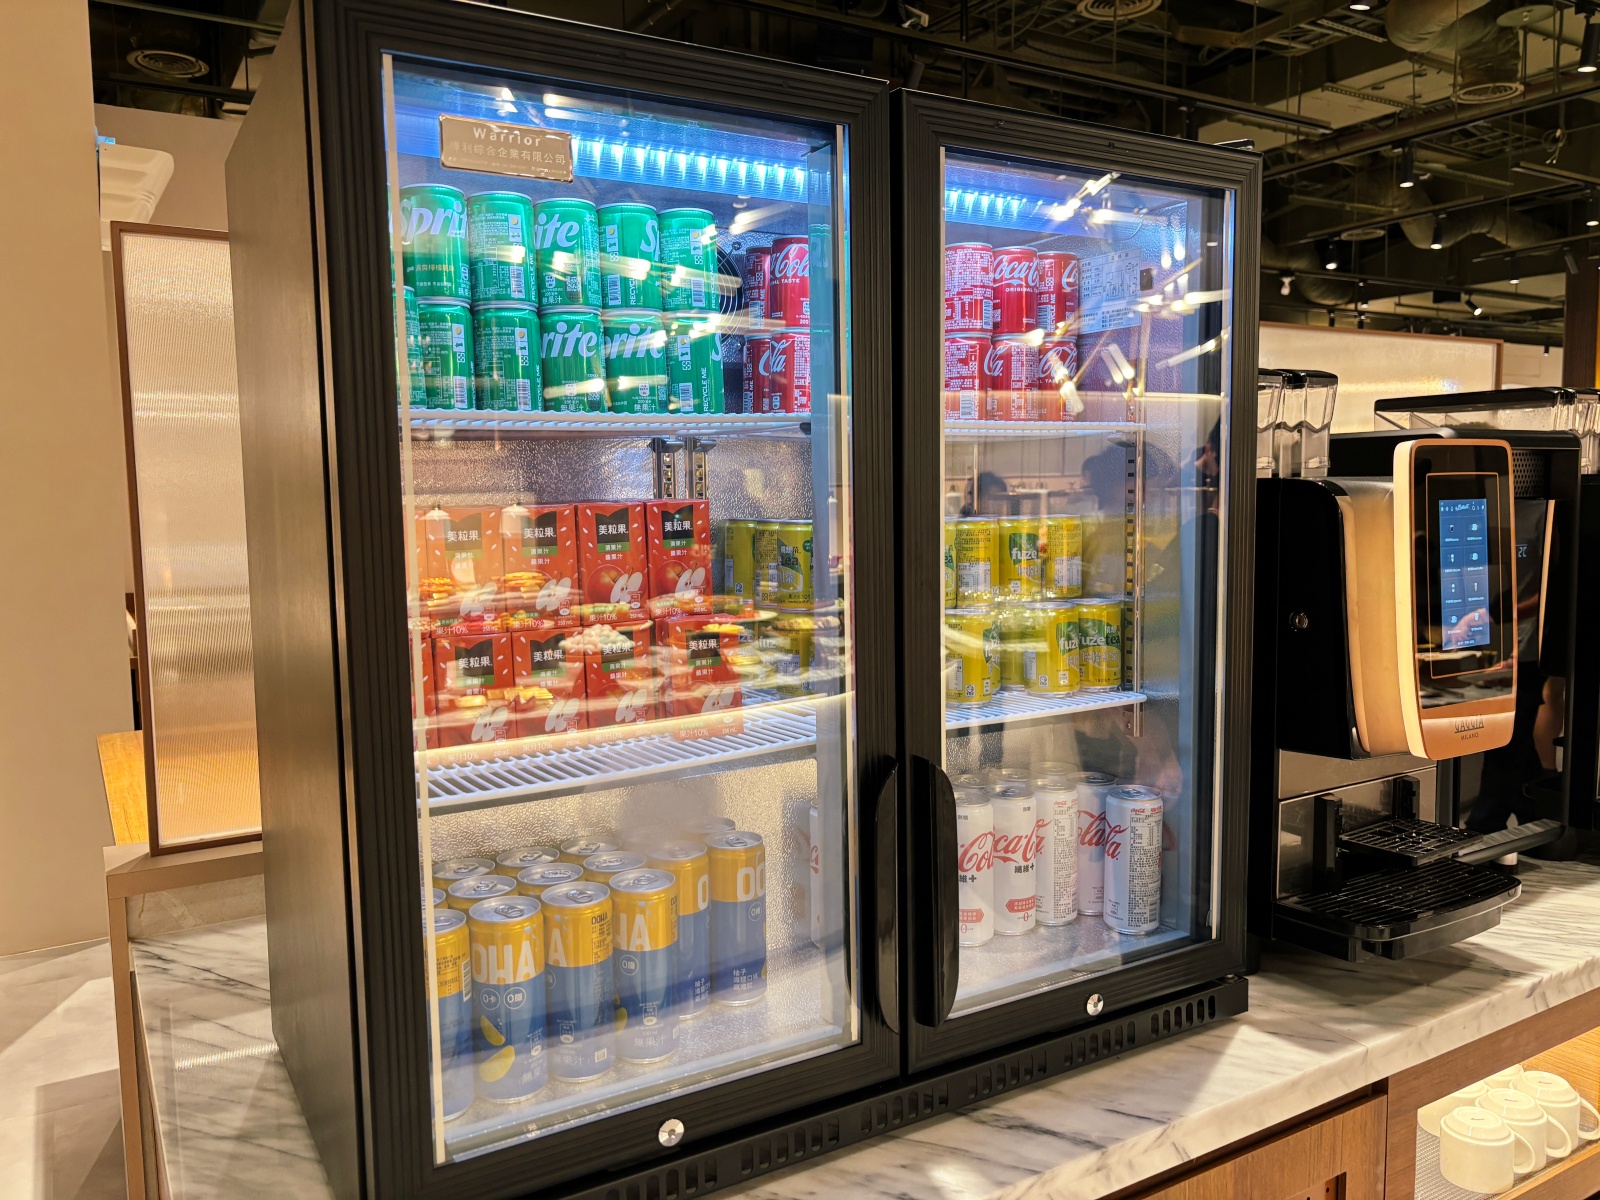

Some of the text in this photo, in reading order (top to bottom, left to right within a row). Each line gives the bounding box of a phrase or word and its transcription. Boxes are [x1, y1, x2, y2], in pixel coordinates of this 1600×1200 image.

[473, 127, 541, 147] Warrior
[523, 527, 556, 539] 美粒果
[598, 524, 629, 536] 美粒果
[664, 521, 693, 532] 美粒果
[447, 530, 481, 542] 美粒果
[1011, 547, 1038, 560] fuze
[603, 642, 633, 655] 美粒果
[688, 638, 720, 651] 美粒果
[458, 656, 493, 670] 美粒果
[533, 650, 565, 663] 美粒果
